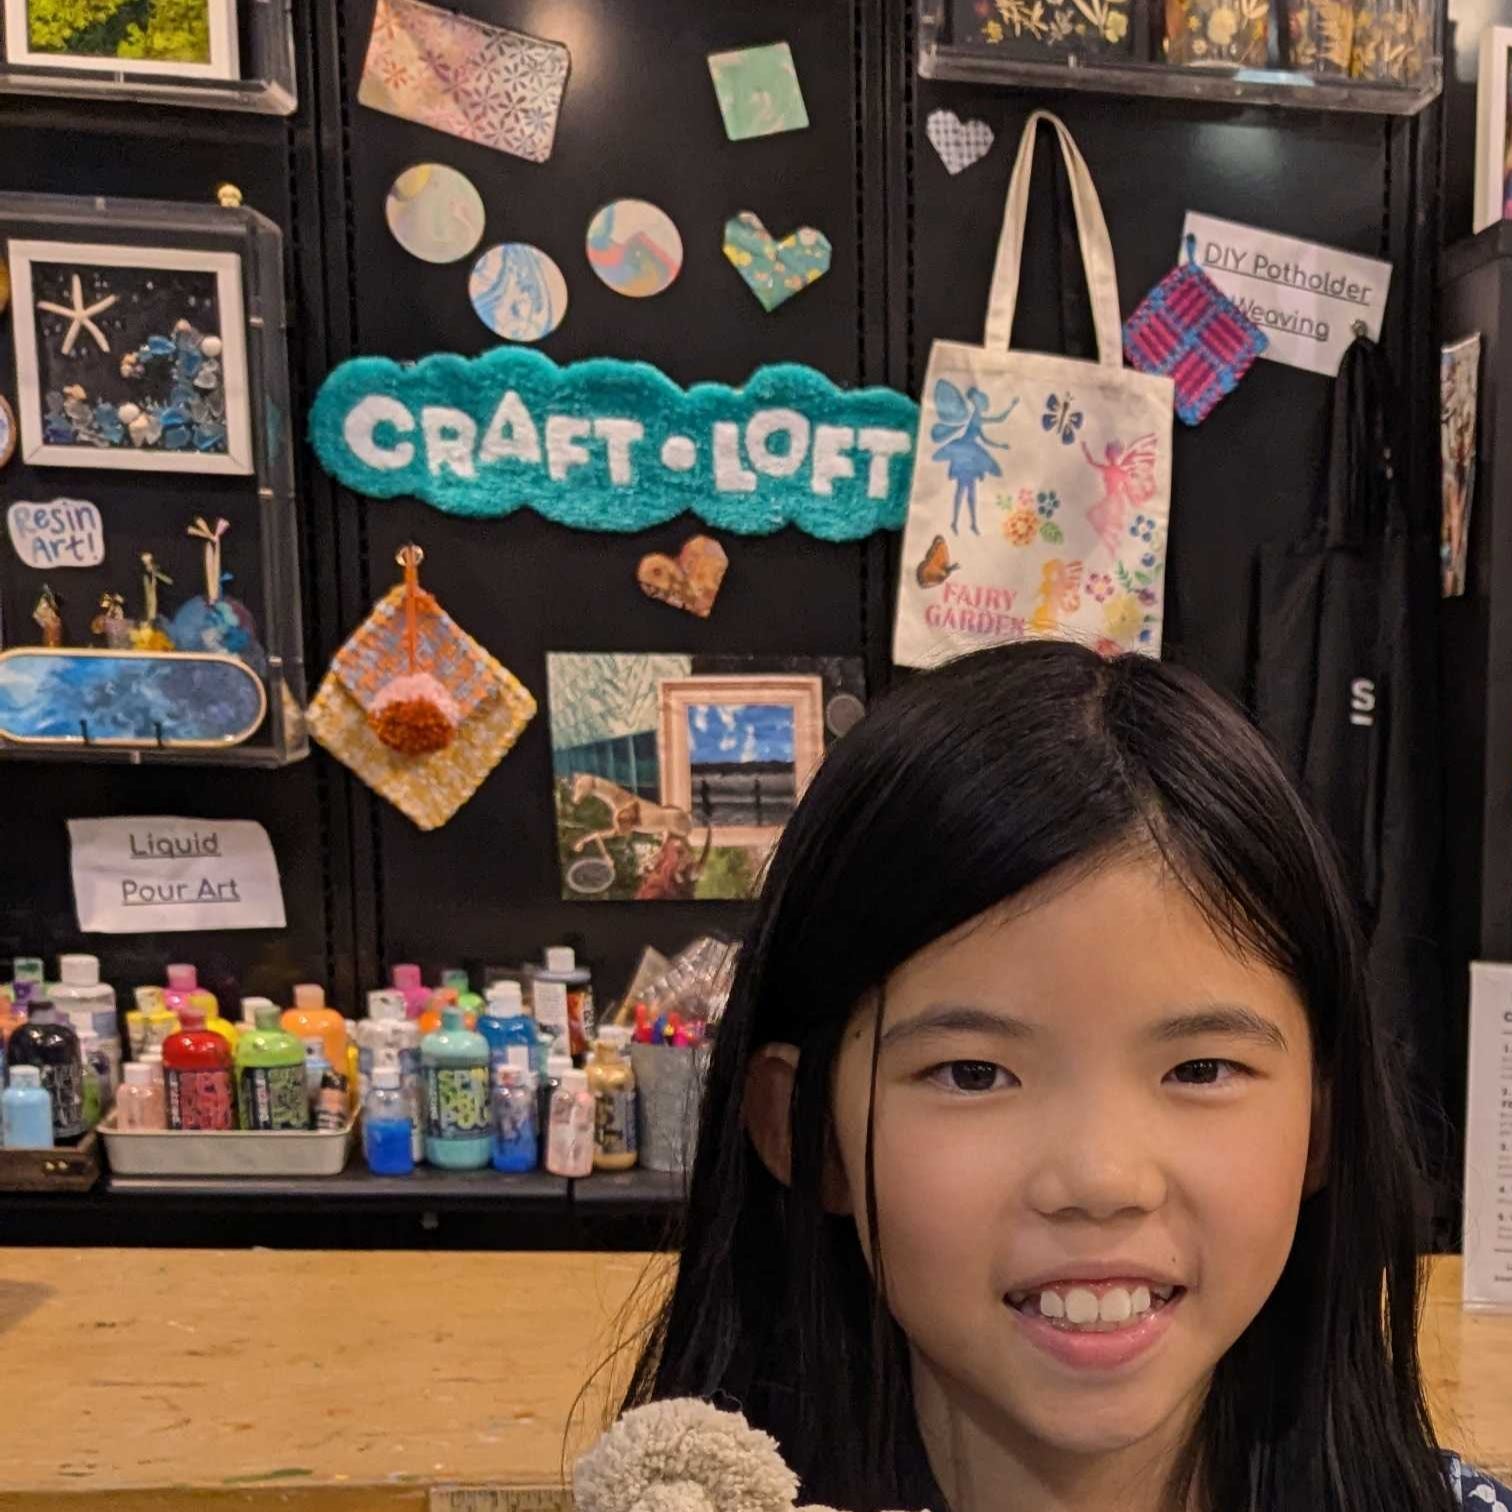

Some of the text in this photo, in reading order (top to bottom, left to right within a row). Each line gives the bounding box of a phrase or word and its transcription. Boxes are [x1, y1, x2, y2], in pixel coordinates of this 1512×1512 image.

[1204, 241, 1372, 302] DIY Potholder
[344, 391, 911, 500] CRAFT LOFT
[14, 502, 96, 538] Resin
[31, 532, 98, 563] Art!
[943, 581, 1018, 612] FAIRY
[924, 604, 1025, 636] GARDEN
[129, 832, 220, 859] Liquid
[122, 878, 239, 902] Pour Art
